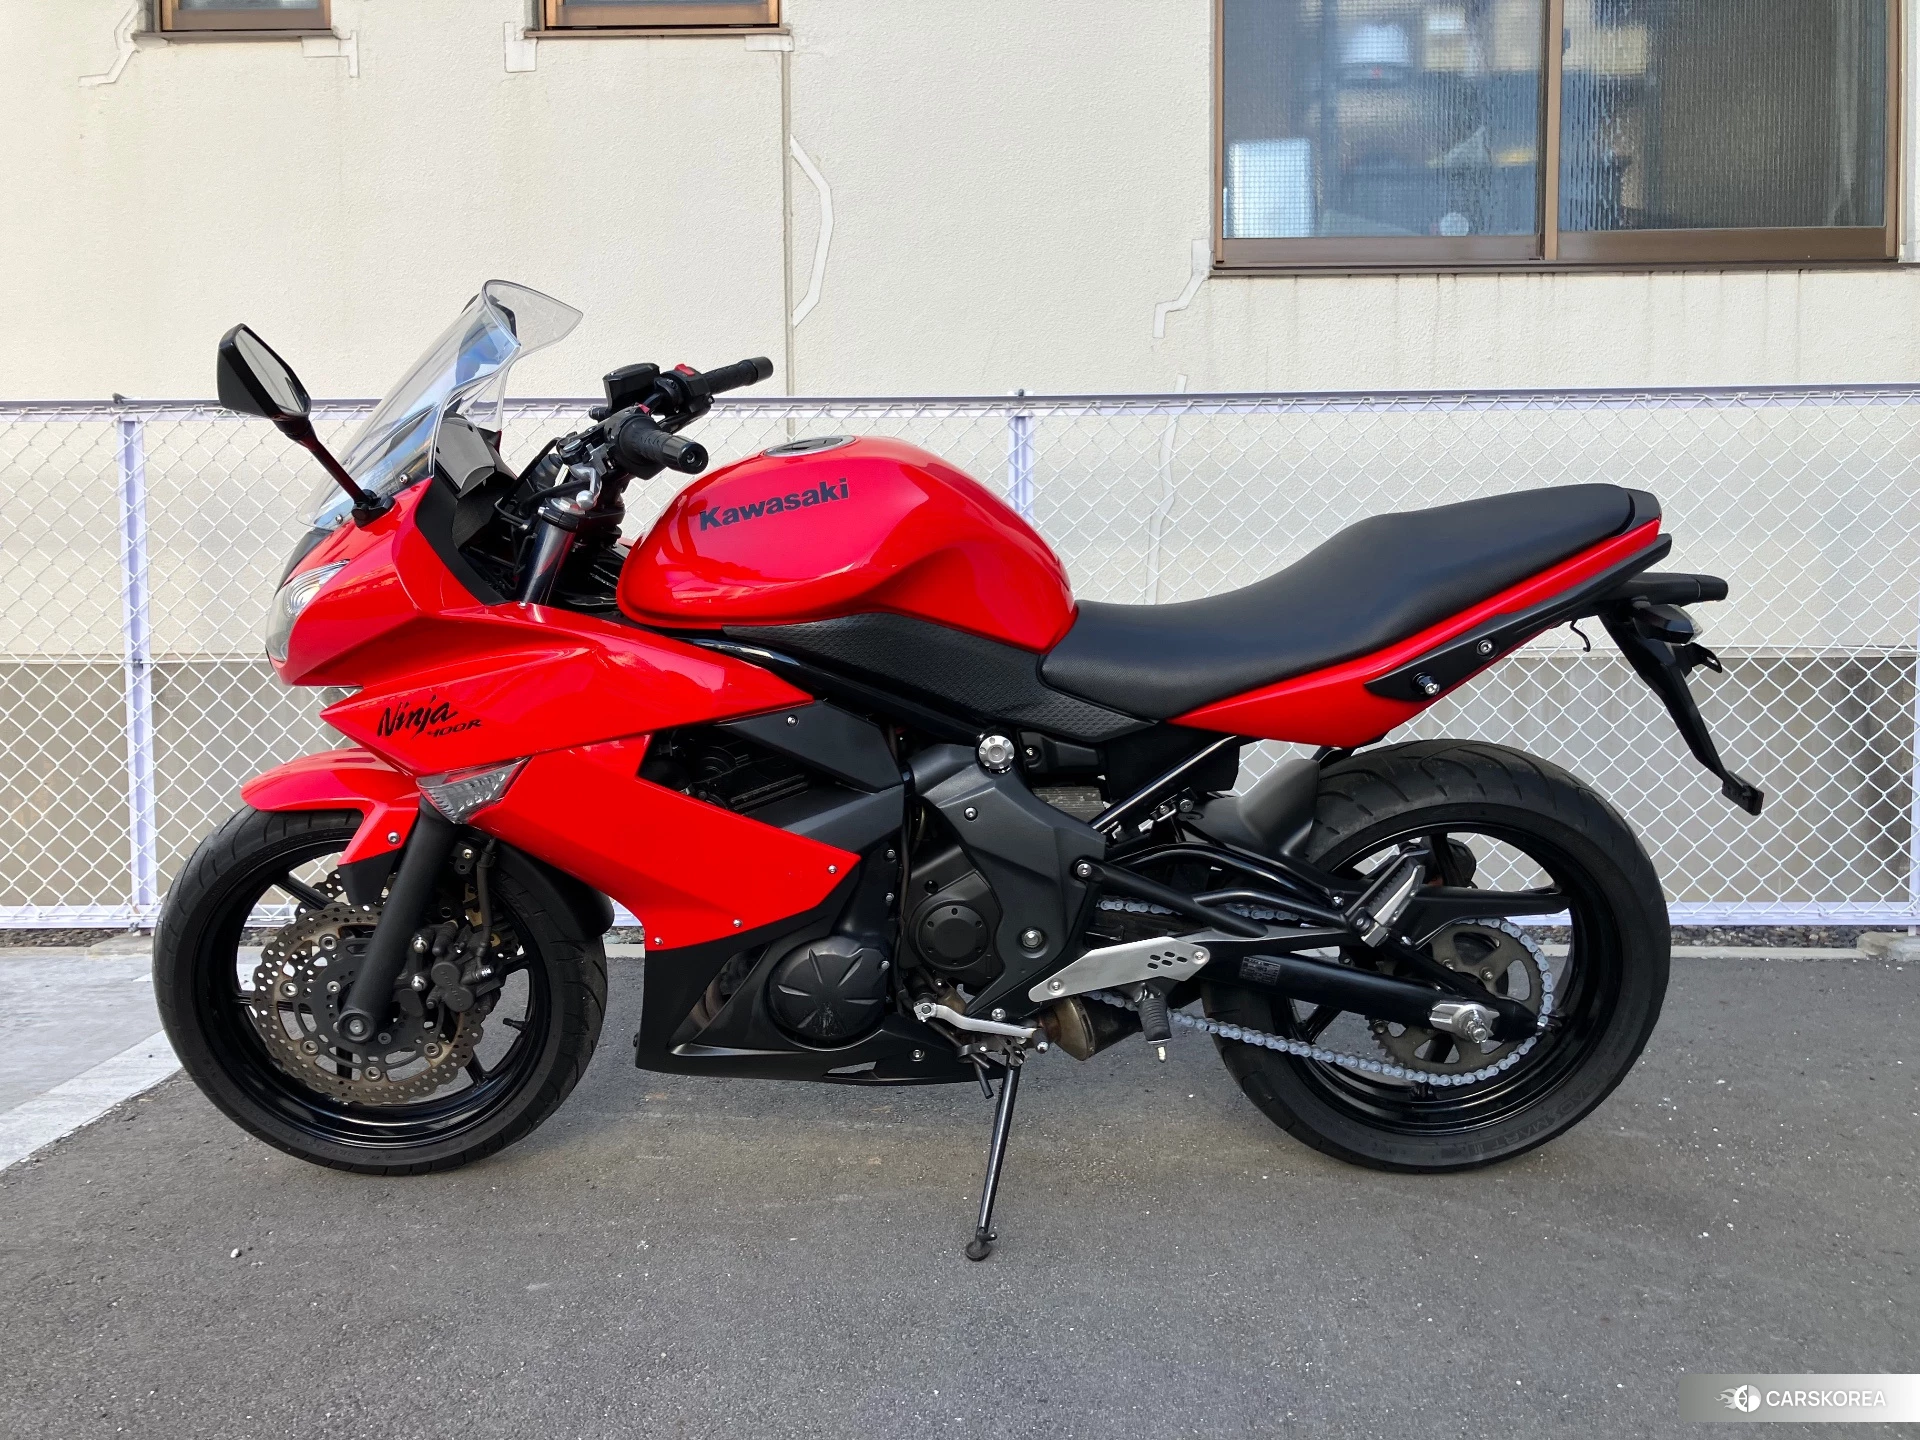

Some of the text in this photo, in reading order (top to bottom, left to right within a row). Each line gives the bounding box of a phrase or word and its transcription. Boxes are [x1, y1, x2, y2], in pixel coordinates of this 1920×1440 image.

[699, 477, 849, 531] Kawasaki
[376, 694, 459, 740] Ninja
[426, 719, 483, 737] 400R
[1492, 1064, 1610, 1150] OADSMART
